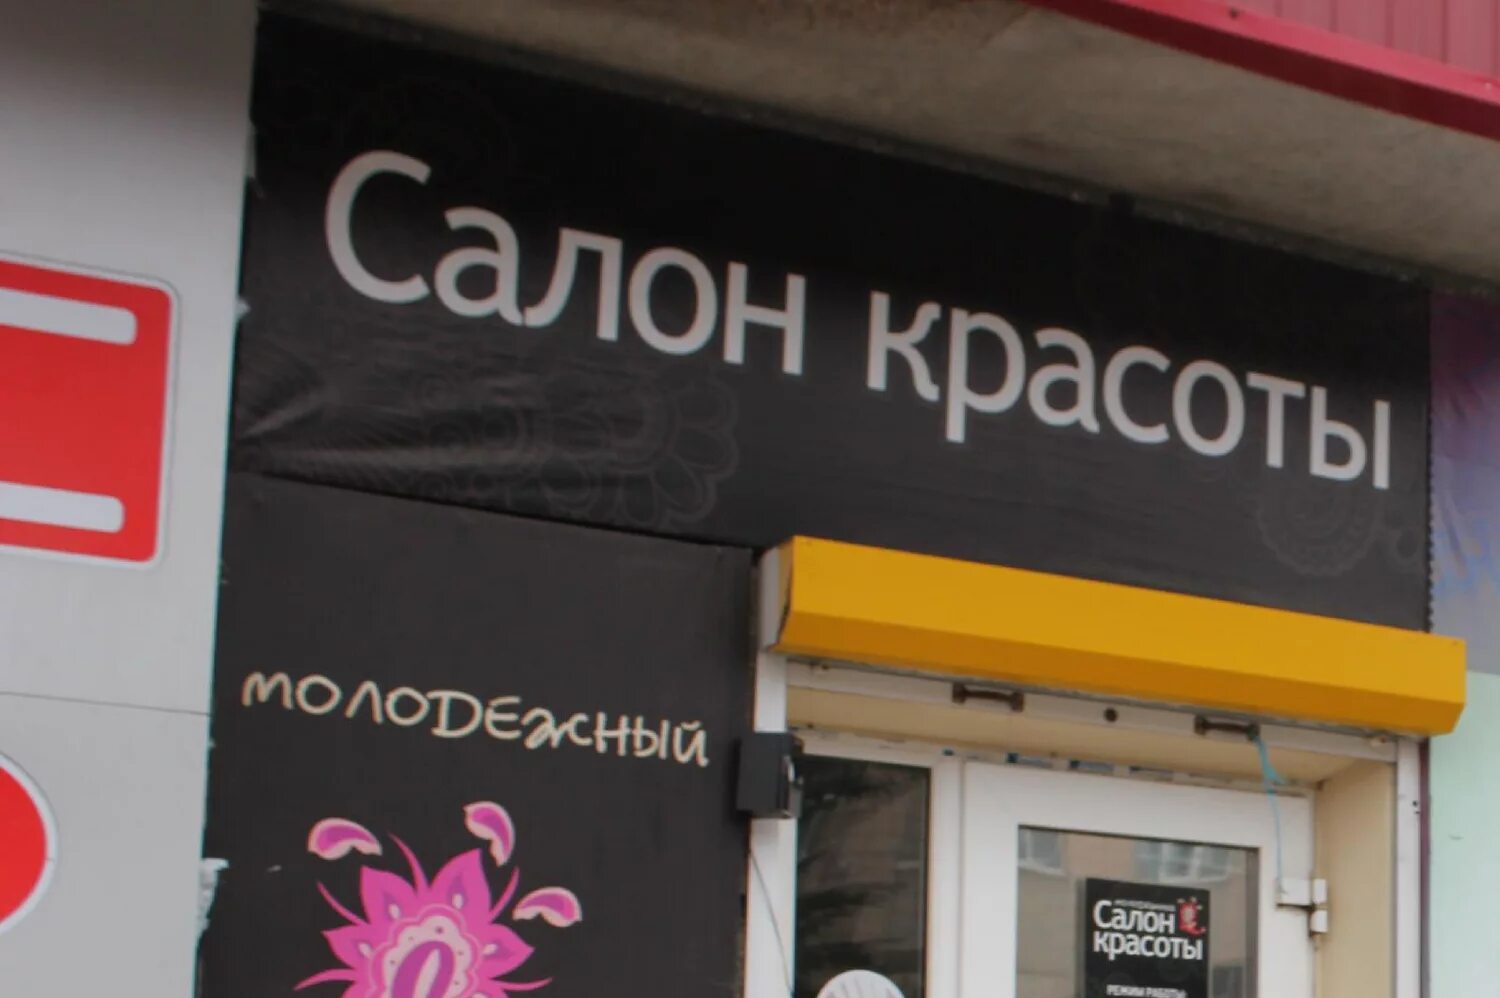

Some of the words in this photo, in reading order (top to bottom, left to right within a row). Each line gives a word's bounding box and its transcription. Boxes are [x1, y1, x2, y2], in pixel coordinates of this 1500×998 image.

[325, 149, 806, 376] Салон
[866, 290, 1391, 490] красоты
[1093, 900, 1175, 935] Салон
[1093, 931, 1203, 961] красоты
